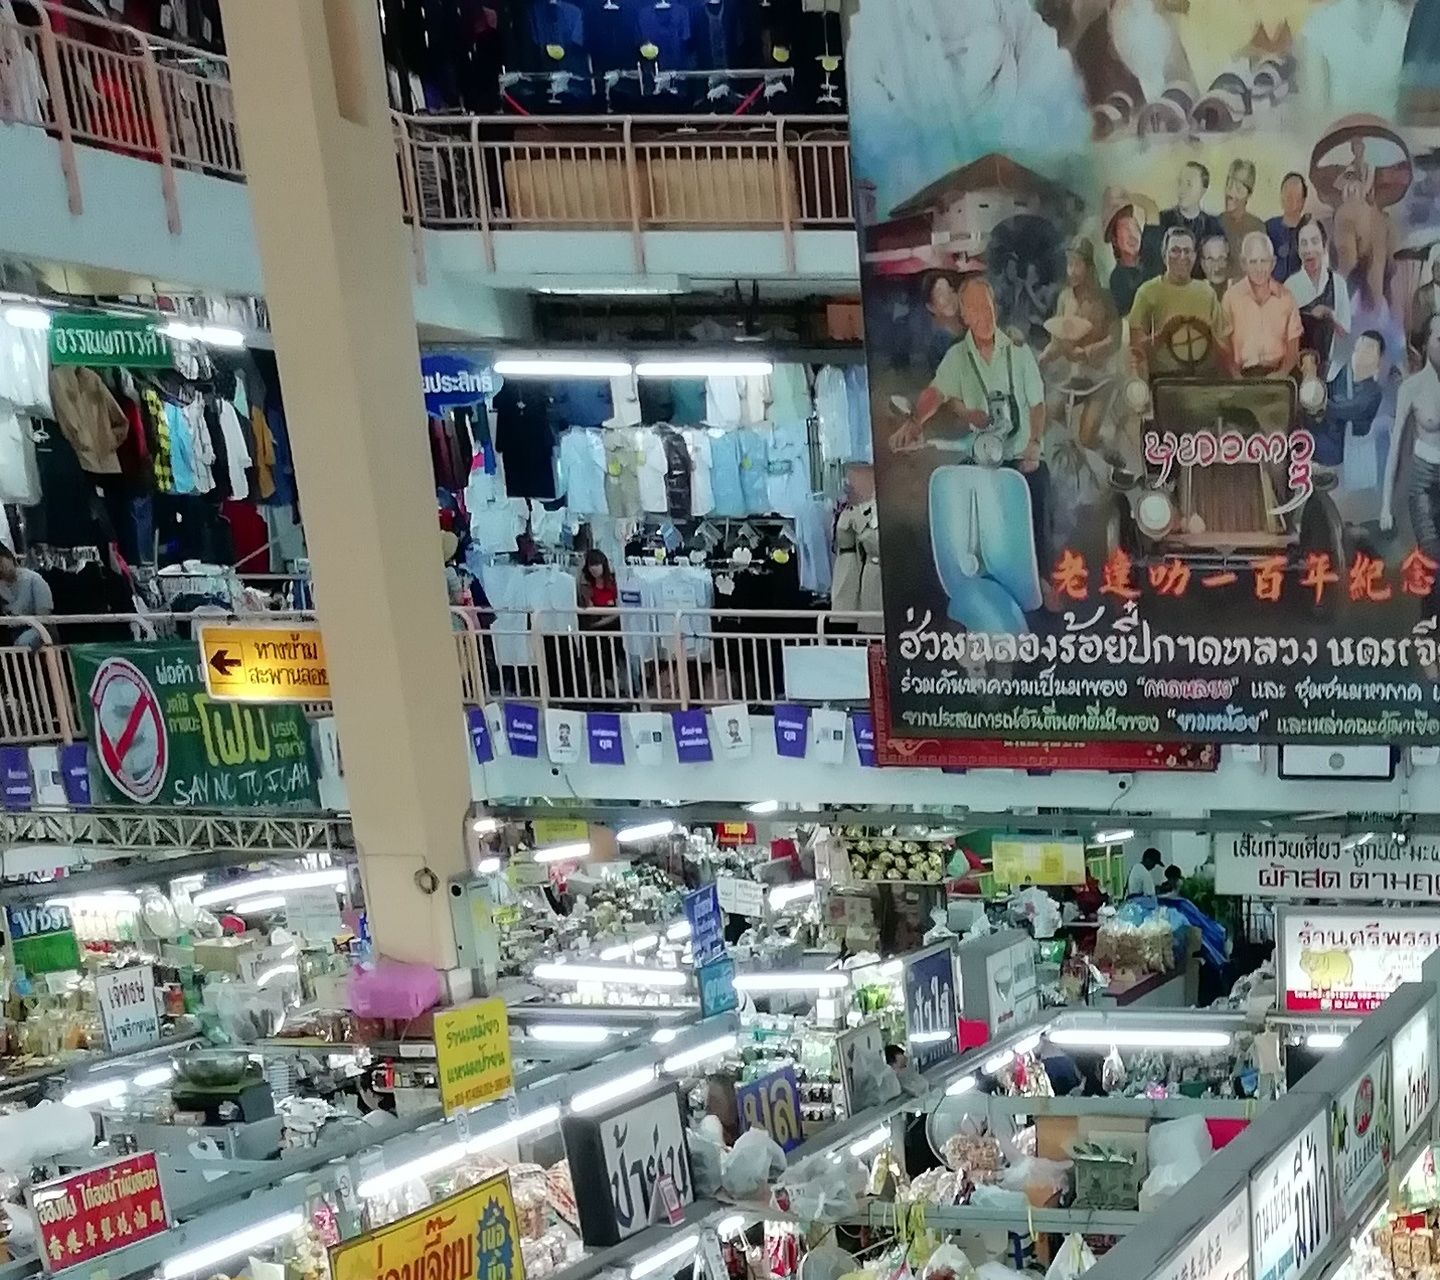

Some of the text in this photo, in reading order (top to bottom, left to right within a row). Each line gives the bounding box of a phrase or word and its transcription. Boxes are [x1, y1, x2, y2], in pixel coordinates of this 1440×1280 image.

[254, 633, 318, 661] ทางข้าม
[1251, 680, 1286, 700] และ
[193, 692, 271, 767] โฟม
[173, 770, 210, 806] SAY
[1258, 861, 1341, 888] ผักสด
